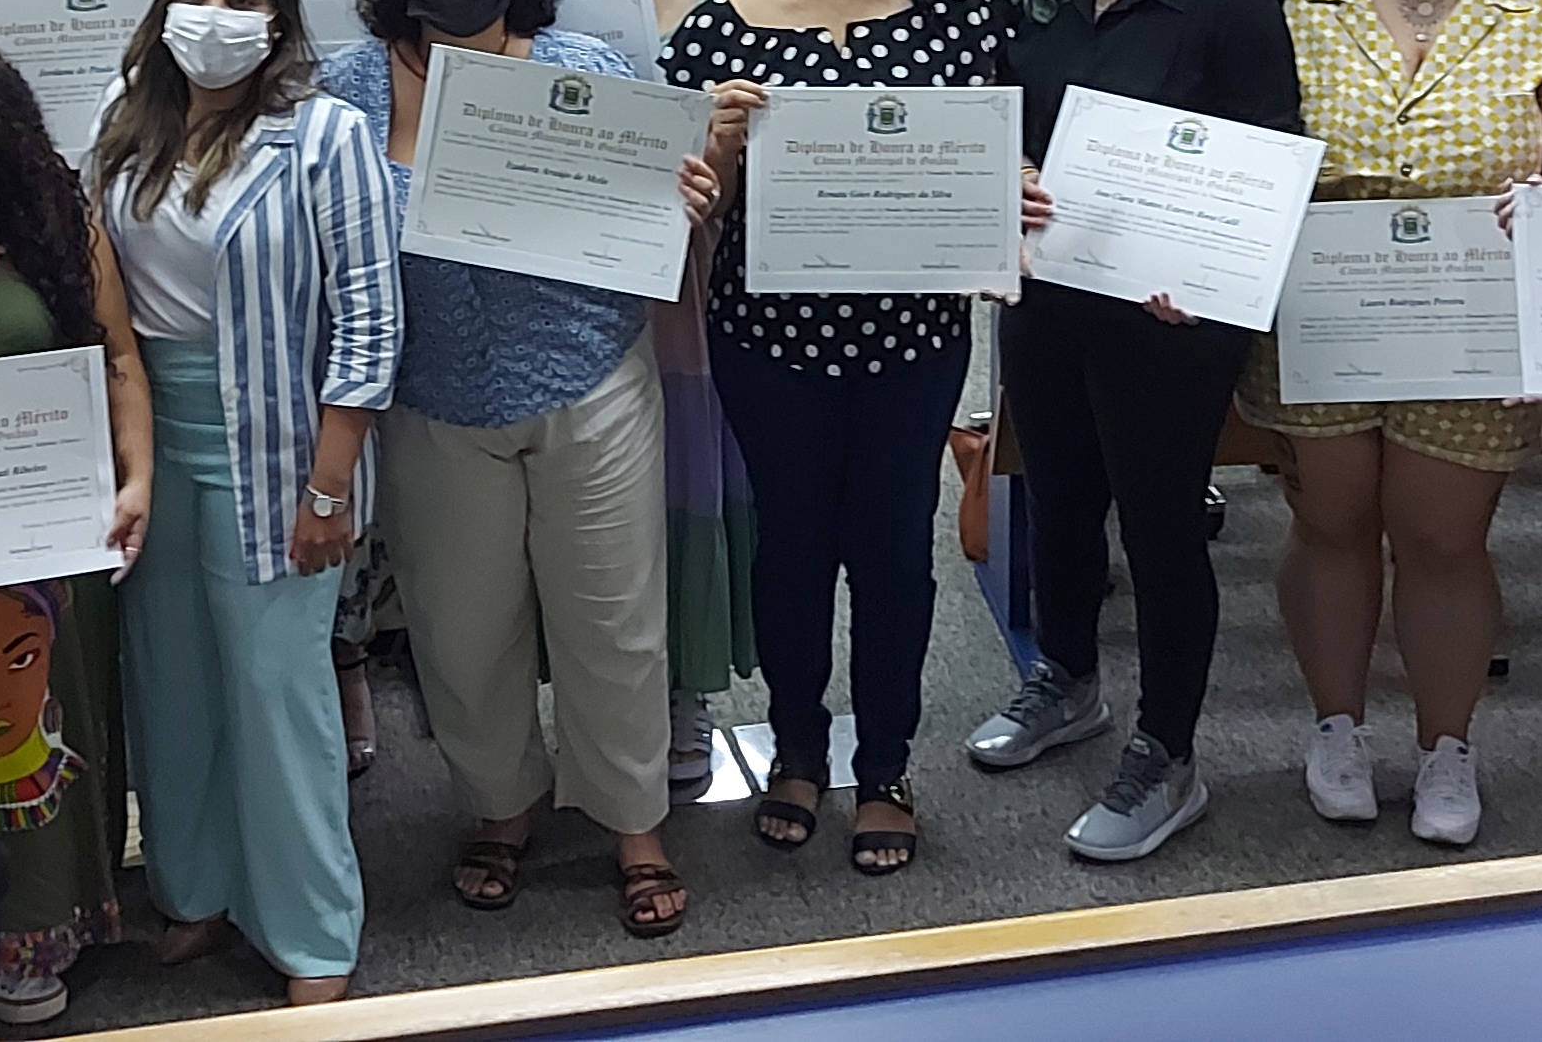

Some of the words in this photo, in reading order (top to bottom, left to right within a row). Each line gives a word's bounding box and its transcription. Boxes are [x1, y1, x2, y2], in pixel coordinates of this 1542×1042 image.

[48, 19, 65, 32] de
[69, 17, 116, 32] Honra
[119, 17, 136, 28] ao
[462, 101, 524, 125] Diploma
[526, 114, 543, 128] de
[548, 115, 594, 137] Honra
[596, 128, 614, 140] ao
[785, 139, 845, 156] Diploma
[849, 140, 864, 153] de
[869, 139, 914, 154] Honra
[917, 143, 934, 154] ao
[1311, 250, 1371, 266] Diploma
[1373, 251, 1389, 263] de
[1393, 248, 1439, 263] Honra
[1442, 251, 1459, 261] ao
